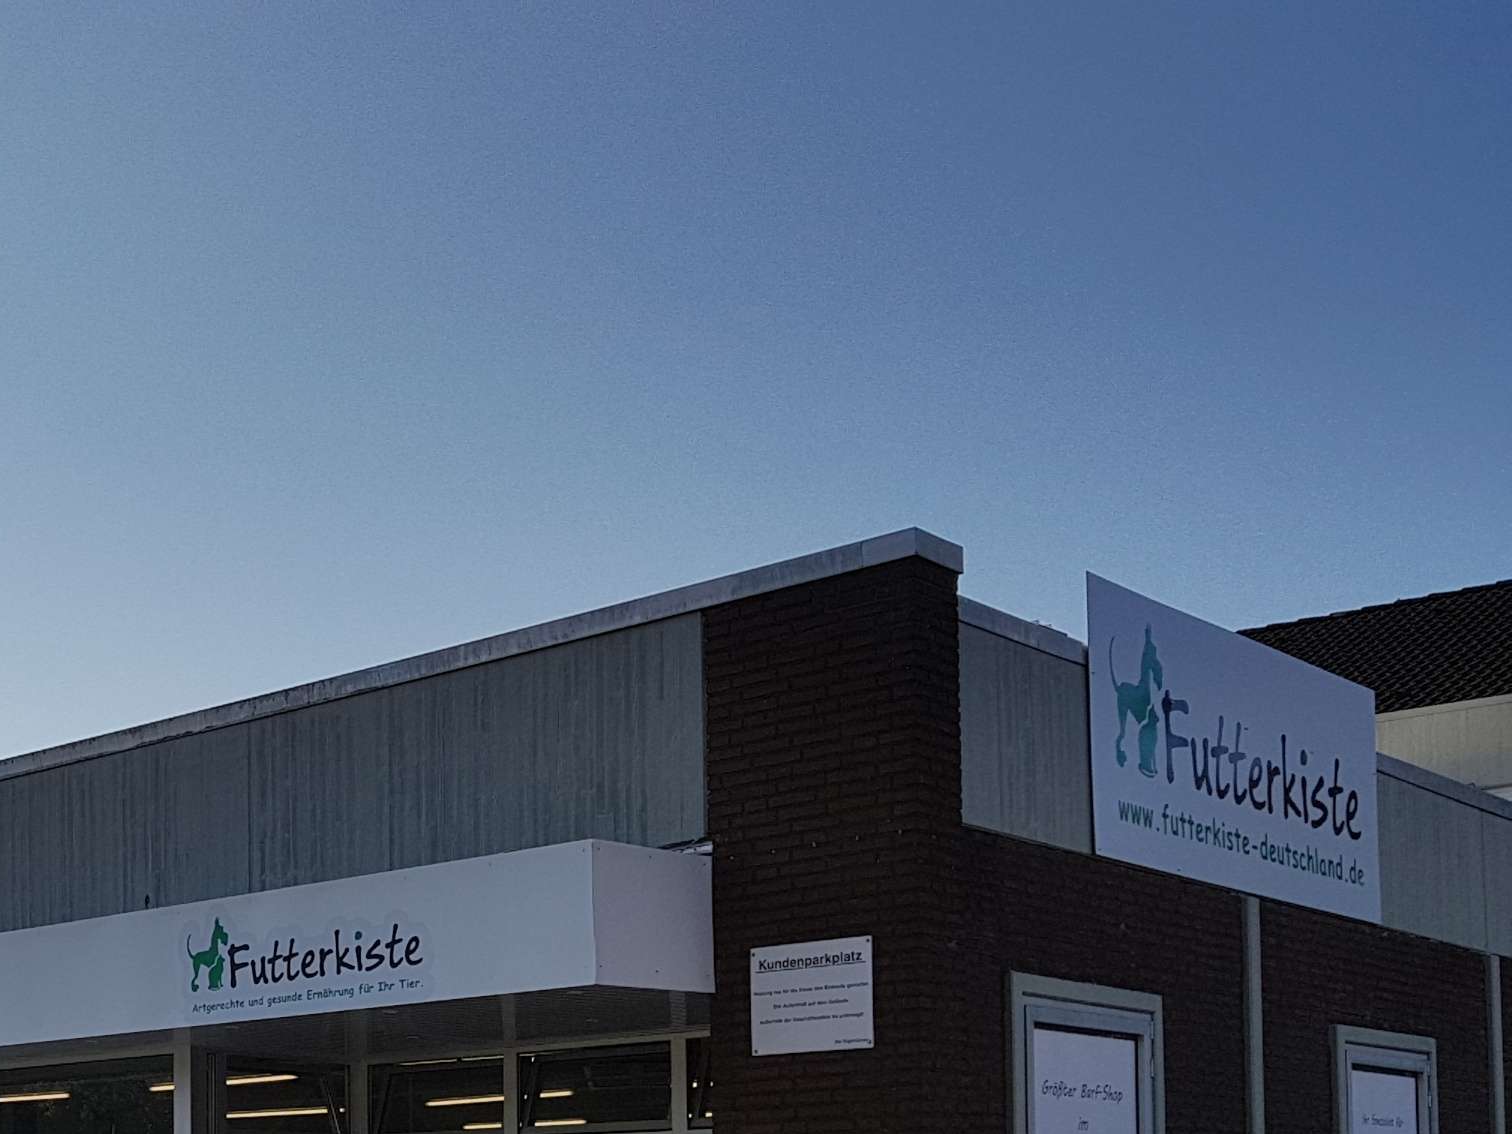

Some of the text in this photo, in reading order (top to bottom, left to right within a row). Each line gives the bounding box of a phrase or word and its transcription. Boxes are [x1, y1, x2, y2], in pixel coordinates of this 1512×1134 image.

[1162, 689, 1363, 841] Futterkiste
[1118, 800, 1365, 887] www.futterkiste-deutschland.de
[228, 924, 423, 988] Futterkiste
[759, 951, 863, 971] Kundenparkplatz
[192, 978, 423, 1014] Artgerechte und gesunde Ernährung für Ihr Tier.
[1041, 1079, 1077, 1100] Größter
[1077, 1116, 1089, 1131] im
